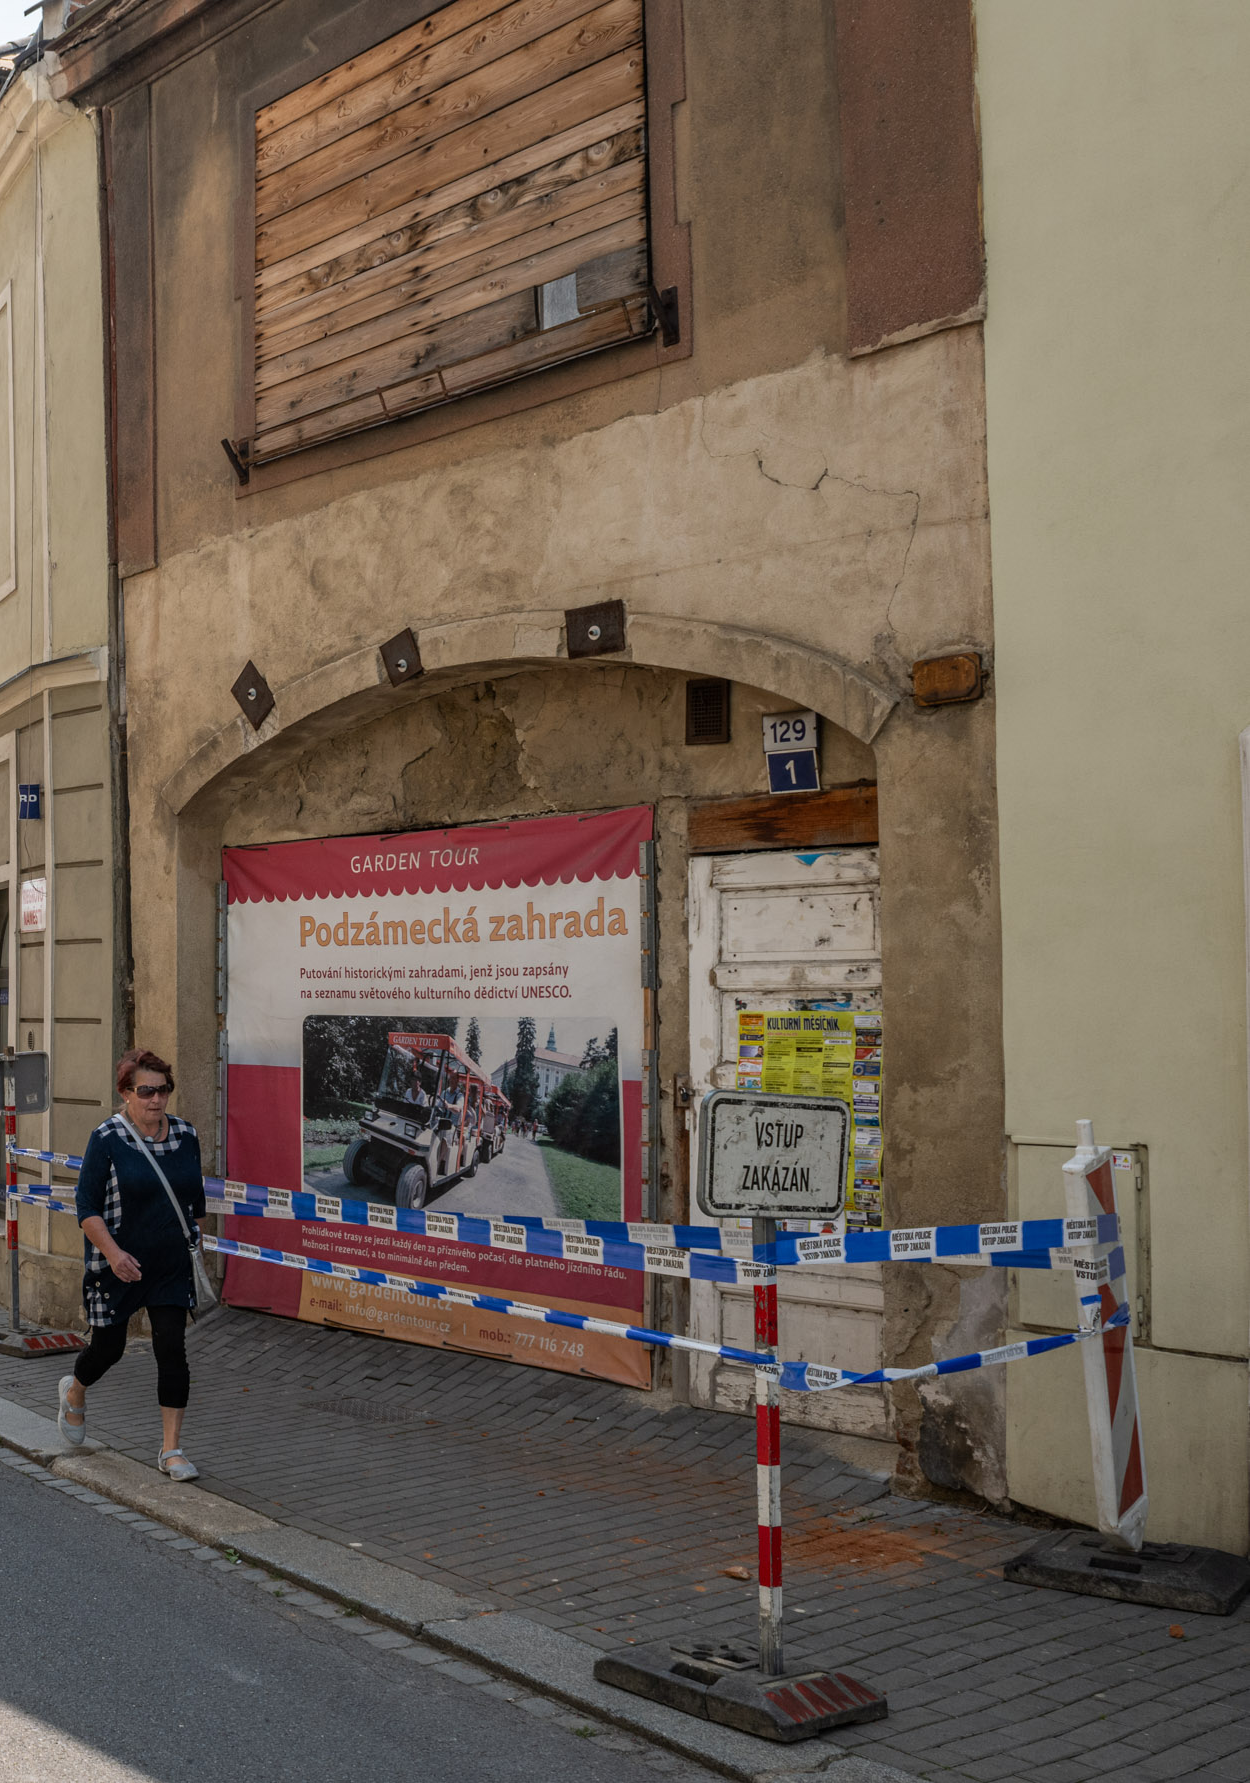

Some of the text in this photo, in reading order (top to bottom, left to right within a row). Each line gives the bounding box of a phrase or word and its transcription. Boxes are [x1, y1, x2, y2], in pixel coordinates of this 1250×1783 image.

[770, 719, 806, 743] 129
[785, 760, 797, 784] 1
[351, 847, 480, 874] GARDEN TOUR
[300, 897, 628, 947] Podzámecká zahrada
[300, 962, 569, 981] Putování historickými zahradami, jenž jsou zapsány
[300, 985, 572, 1000] na seznamu světového kulturního dědictví UNESCO.
[767, 1014, 840, 1031] KULTURNÍ MĚSÍČNÍK
[393, 1035, 439, 1047] GARDEN TOUR
[755, 1121, 804, 1149] VSTUP
[742, 1160, 810, 1192] ZAKÁZÁN
[493, 1223, 524, 1236] MĚSTSKÁ POLICIE
[892, 1230, 932, 1242] MĚSTSKÁ POLICIE
[980, 1223, 1018, 1236] MĚSTSKÁ POLICIE
[493, 1234, 506, 1243] VSTUP
[565, 1234, 600, 1247] MĚSTSKÁ POLICIE
[799, 1237, 841, 1250] MĚSTSKÁ POLICIE
[981, 1236, 997, 1246] VSTUP
[302, 1225, 627, 1280] Prohlídkové trasy se jezdí každý den za příznivého počasí, dle platného jízdního řádu.
[566, 1244, 599, 1257] VSTUP ZAKÁZÁN
[646, 1245, 687, 1258] MĚSTSKÁ POLICIE
[893, 1240, 931, 1252] VSTUP ZAKÁZÁN
[302, 1238, 329, 1251] Možnost
[335, 1245, 370, 1258] rezervací,
[378, 1250, 386, 1259] to
[387, 1251, 423, 1266] minimálně
[423, 1257, 437, 1268] den
[439, 1260, 470, 1273] předem.
[647, 1257, 662, 1267] VSTUP
[802, 1251, 820, 1260] VSTUP
[742, 1268, 761, 1278] VSTUP
[311, 1275, 453, 1311] www.gardentour.cz
[310, 1297, 451, 1333] e-mail: info@gardentour.cz
[479, 1328, 585, 1357] mob.: 777 116 748
